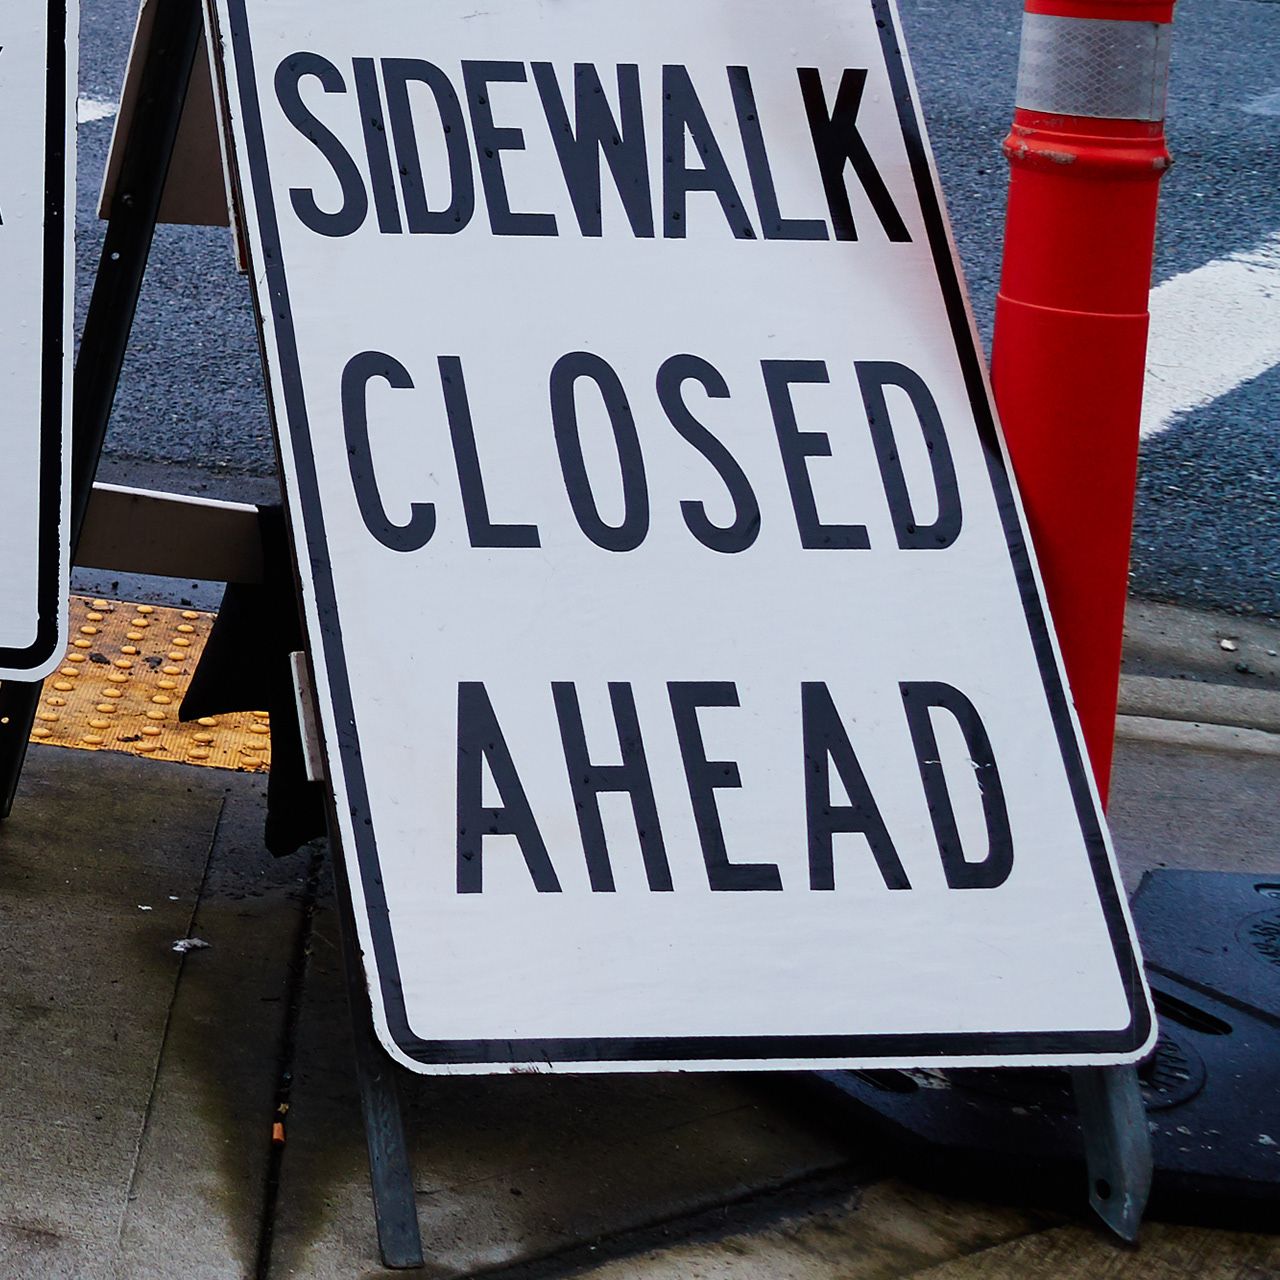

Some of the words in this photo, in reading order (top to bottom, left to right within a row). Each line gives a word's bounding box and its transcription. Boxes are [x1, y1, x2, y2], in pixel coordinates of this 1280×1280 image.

[274, 52, 912, 243] SIDEWALK
[341, 350, 963, 555] CLOSED
[456, 681, 1014, 894] AHEAD
